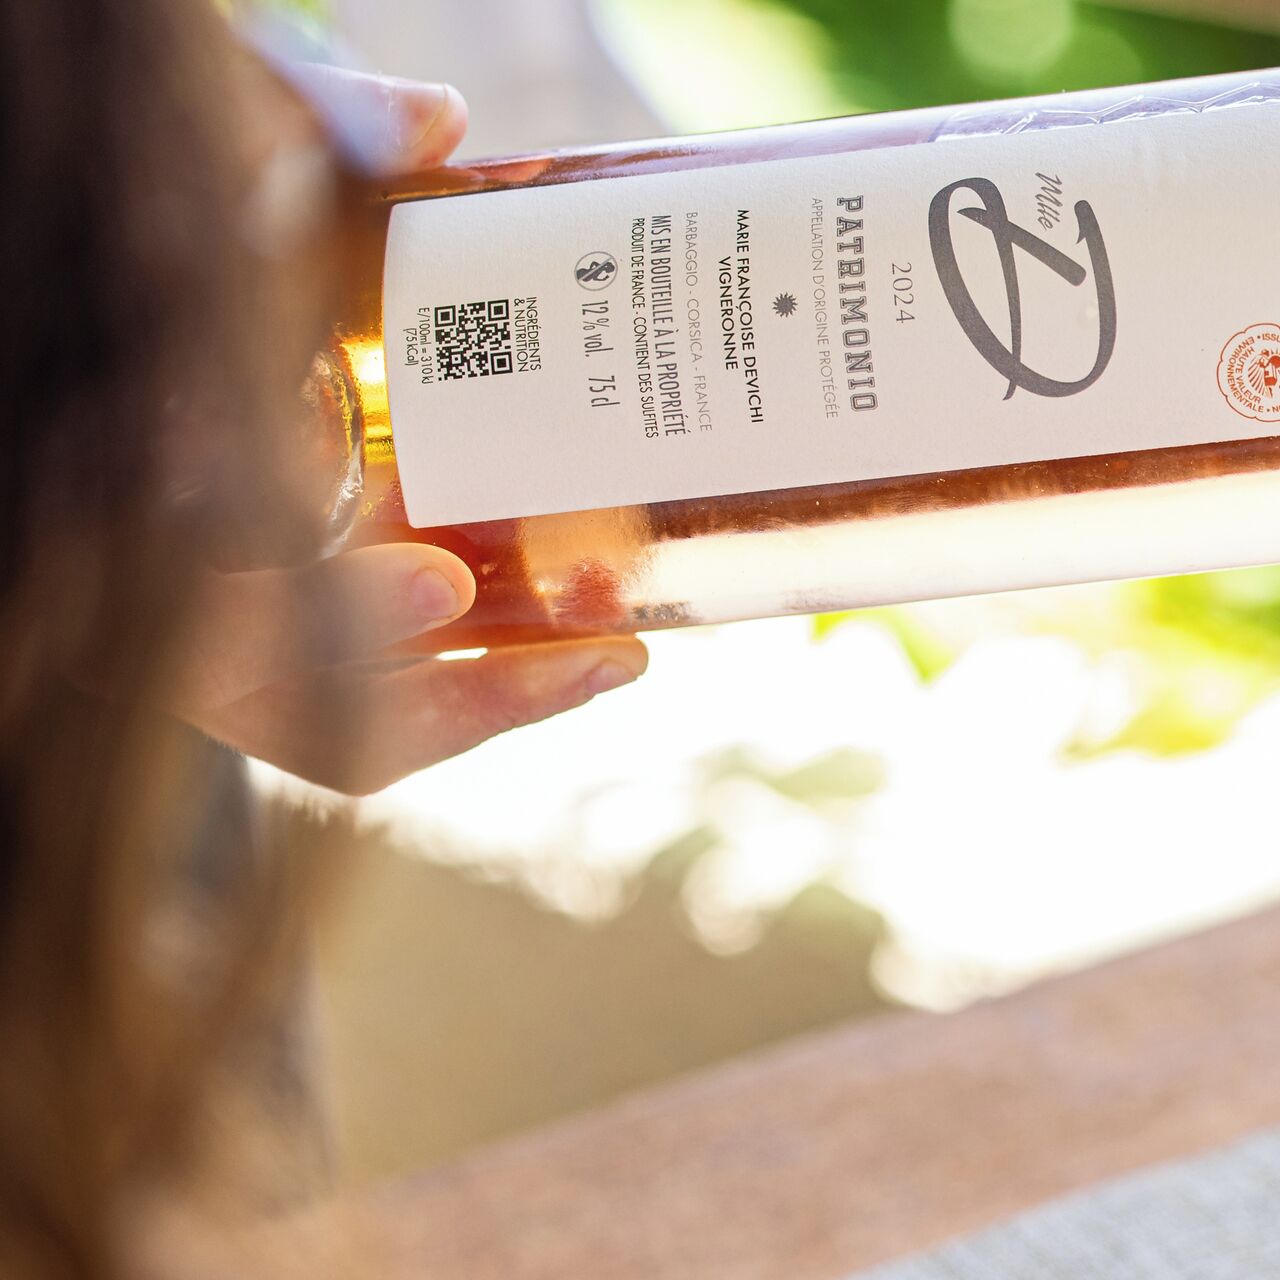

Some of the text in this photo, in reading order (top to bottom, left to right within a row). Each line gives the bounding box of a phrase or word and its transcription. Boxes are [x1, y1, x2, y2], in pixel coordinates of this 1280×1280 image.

[631, 218, 646, 253] PRODUIT
[631, 255, 644, 268] DE
[685, 212, 698, 286] BARBAGGIO
[581, 300, 609, 315] 12
[631, 270, 646, 309] FRANCE
[718, 256, 739, 370] VIGNERONNE
[735, 209, 764, 423] MARIE FRANÇOISE DEVICHI
[811, 197, 839, 419] APPELLATION D'ORIGINE PROTÉGÉE
[836, 194, 879, 412] PATRIMONIO
[891, 261, 915, 324] 2024
[514, 298, 529, 372] & NUTRITION
[526, 296, 541, 371] INGRÉDIENTS
[583, 333, 614, 358] vol.
[633, 316, 651, 370] CONTIENT
[650, 215, 692, 437] MIS EN BOUTEILLE À LA PROPRIÉTÉ
[686, 298, 703, 363] CORSICA
[588, 375, 616, 393] 75
[590, 397, 621, 407] cl
[638, 373, 653, 393] DES
[693, 375, 713, 432] FRANCE
[1227, 337, 1264, 413] ENVIRONNEMENTALE
[1236, 347, 1261, 404] HAUTE VALEUR
[640, 396, 659, 439] SULFITES
